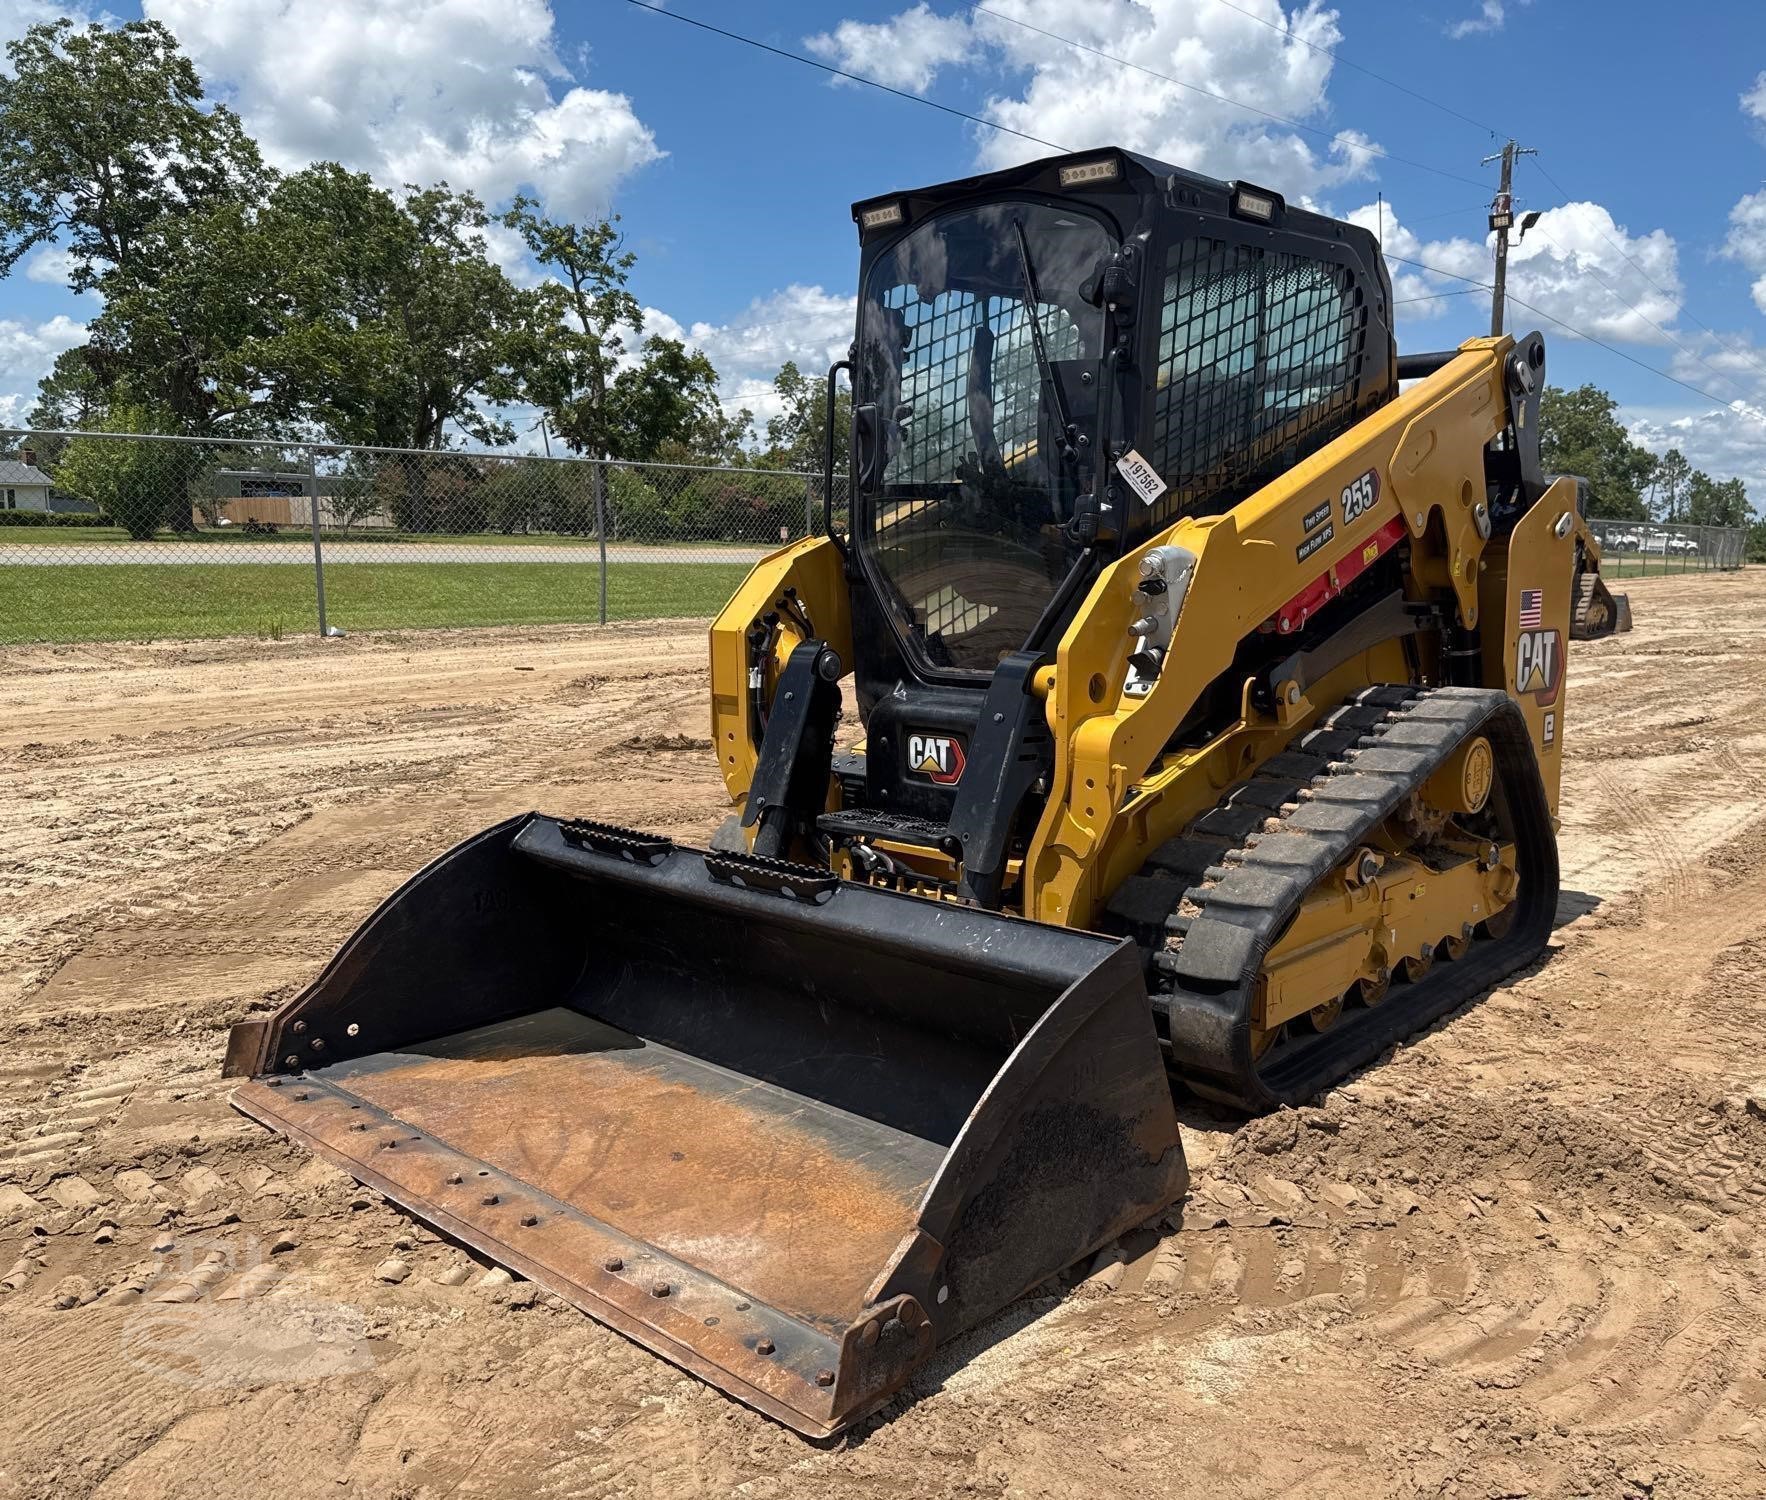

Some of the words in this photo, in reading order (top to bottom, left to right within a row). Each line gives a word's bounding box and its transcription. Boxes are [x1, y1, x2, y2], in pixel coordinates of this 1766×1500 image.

[1129, 461, 1159, 494] 197562
[1341, 473, 1373, 524] 255
[1516, 631, 1555, 693] CAT
[909, 736, 950, 772] CAT
